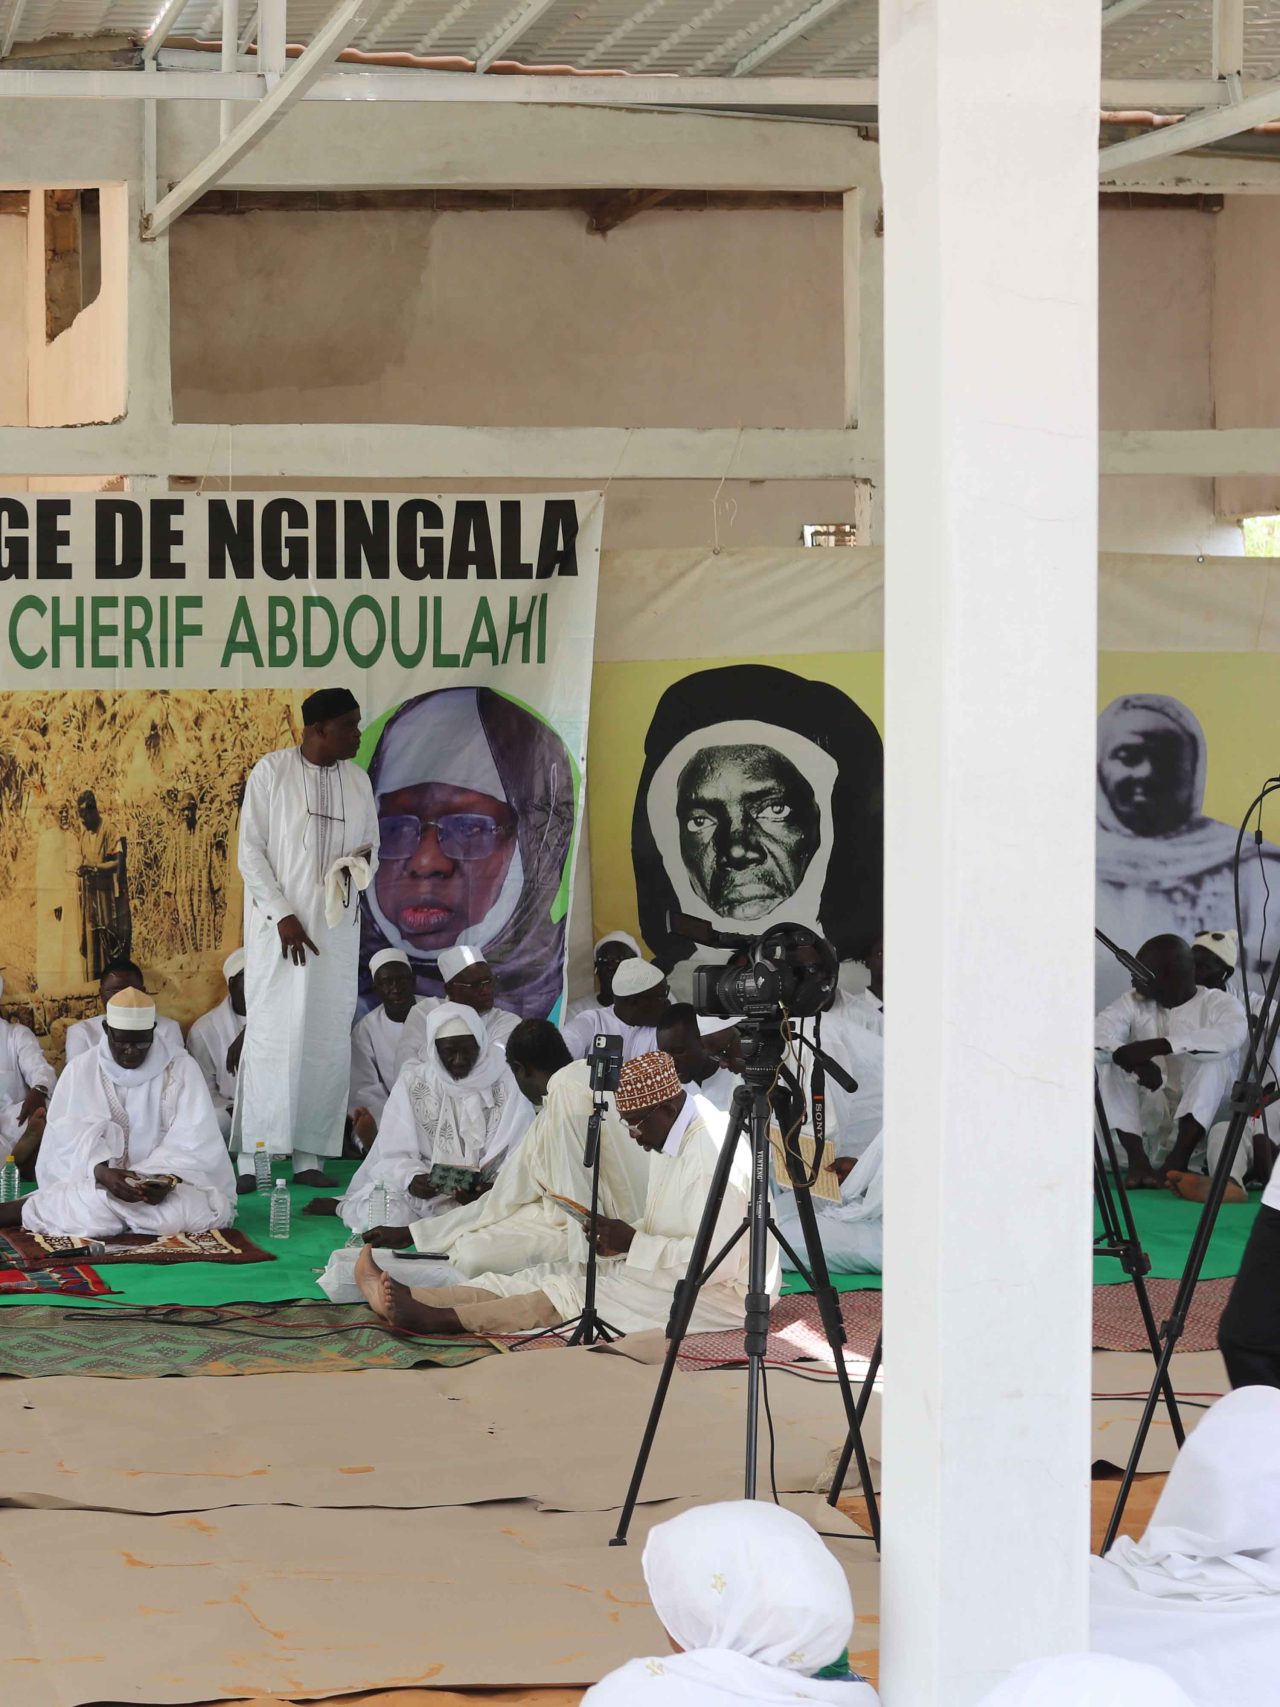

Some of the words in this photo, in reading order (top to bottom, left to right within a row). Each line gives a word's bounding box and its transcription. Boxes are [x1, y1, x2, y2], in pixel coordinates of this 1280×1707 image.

[94, 499, 187, 580] DE
[208, 497, 580, 581] NGINGALA
[7, 594, 204, 670] CHERIF
[220, 592, 549, 670] ABDOULAHI
[815, 1103, 824, 1141] SONY
